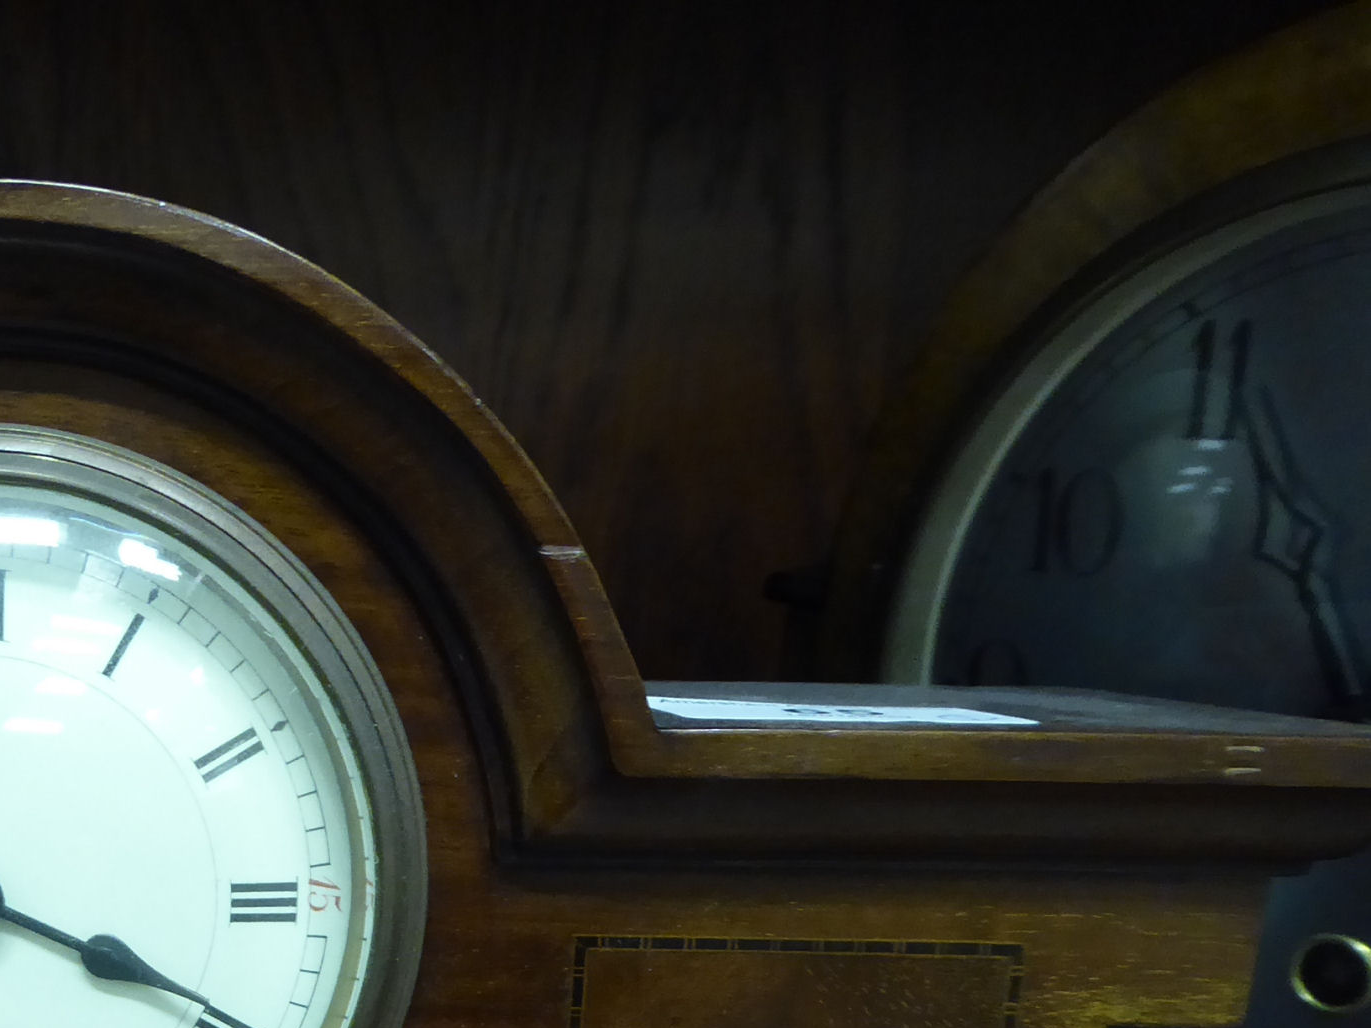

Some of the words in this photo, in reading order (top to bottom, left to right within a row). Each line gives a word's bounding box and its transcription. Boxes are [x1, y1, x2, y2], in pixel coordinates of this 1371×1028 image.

[102, 612, 147, 681] I
[191, 726, 269, 789] II
[229, 875, 299, 924] III
[308, 875, 343, 914] 15
